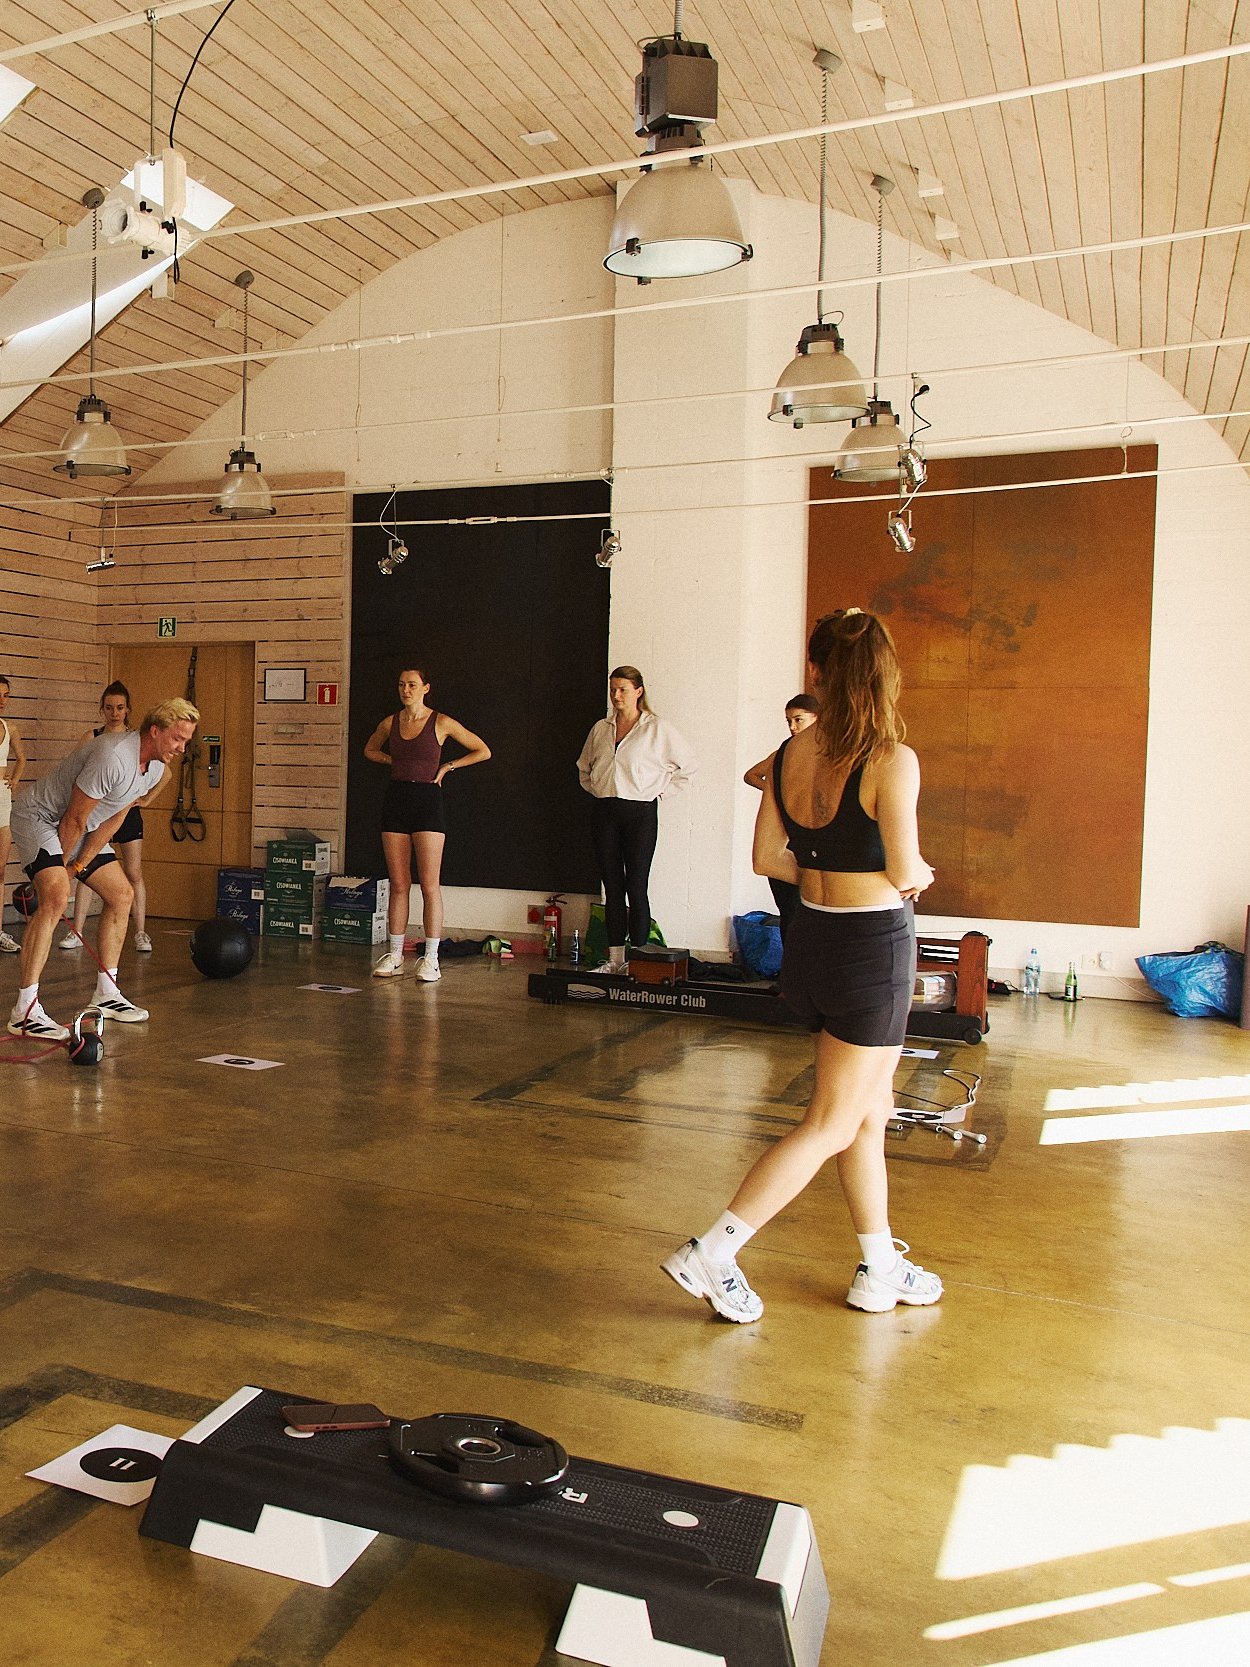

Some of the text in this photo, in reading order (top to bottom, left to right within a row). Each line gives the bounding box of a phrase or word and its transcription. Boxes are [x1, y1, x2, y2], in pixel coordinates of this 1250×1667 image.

[609, 988, 707, 1008] WaterRower Club
[722, 1277, 738, 1293] N
